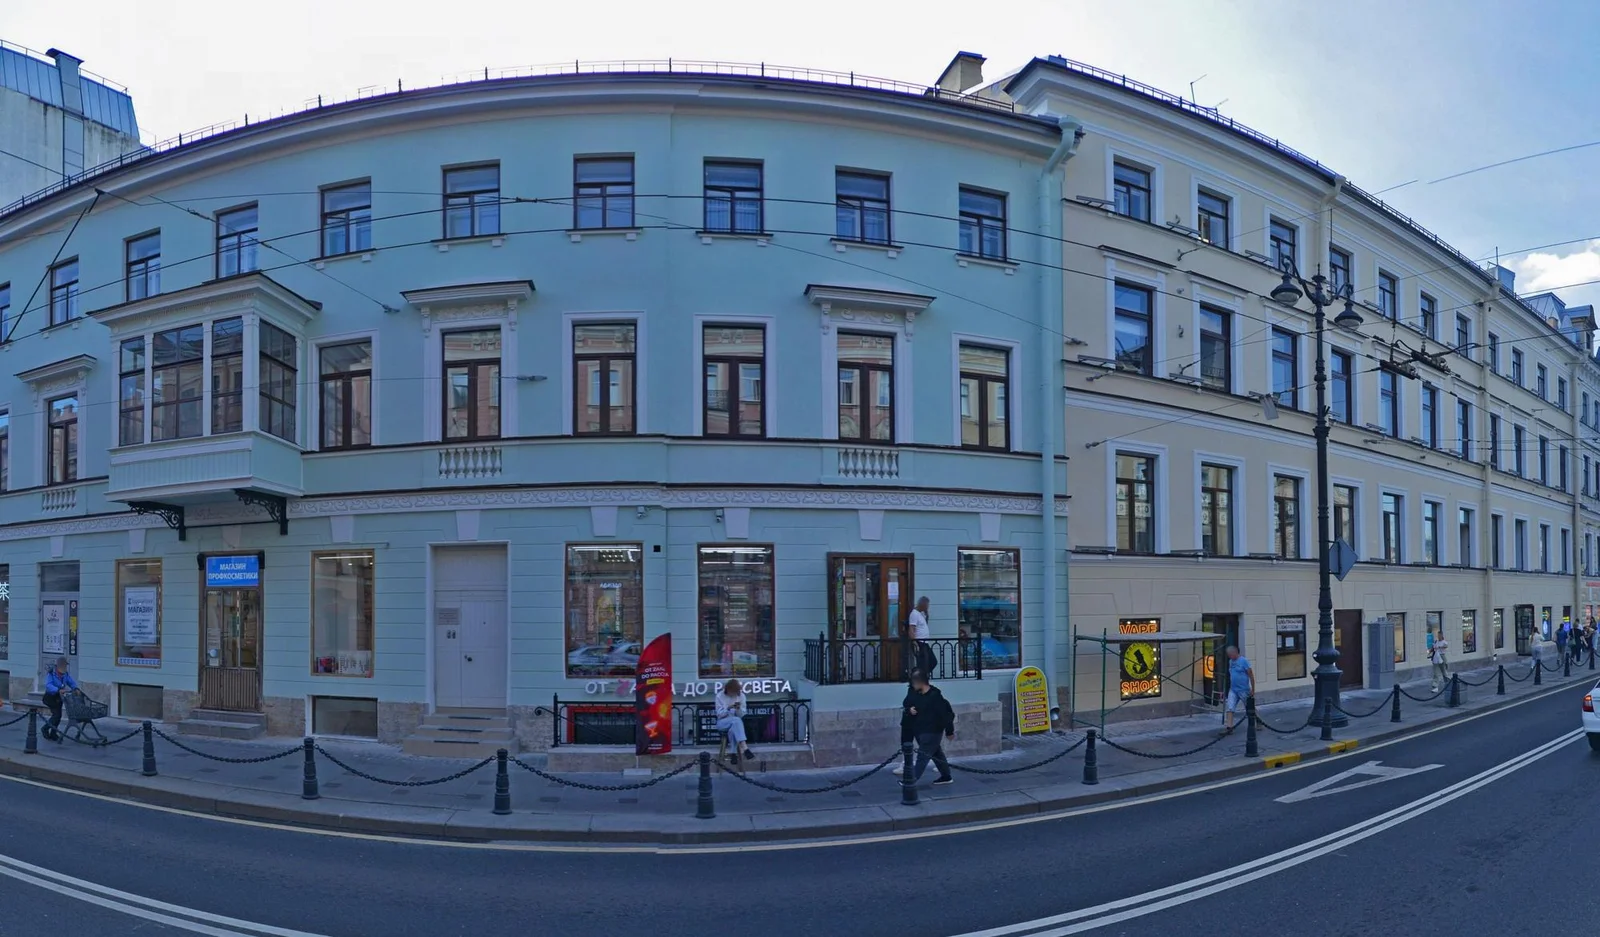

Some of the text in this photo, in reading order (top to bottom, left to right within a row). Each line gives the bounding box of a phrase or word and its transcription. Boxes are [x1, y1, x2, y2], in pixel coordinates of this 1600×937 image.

[208, 572, 258, 580] ПРОФКОСМЕТИКИ
[127, 606, 154, 614] МАГАЗИН
[683, 682, 708, 697] ДО
[714, 680, 792, 696] РСВЕТА
[1121, 681, 1159, 693] SHOP
